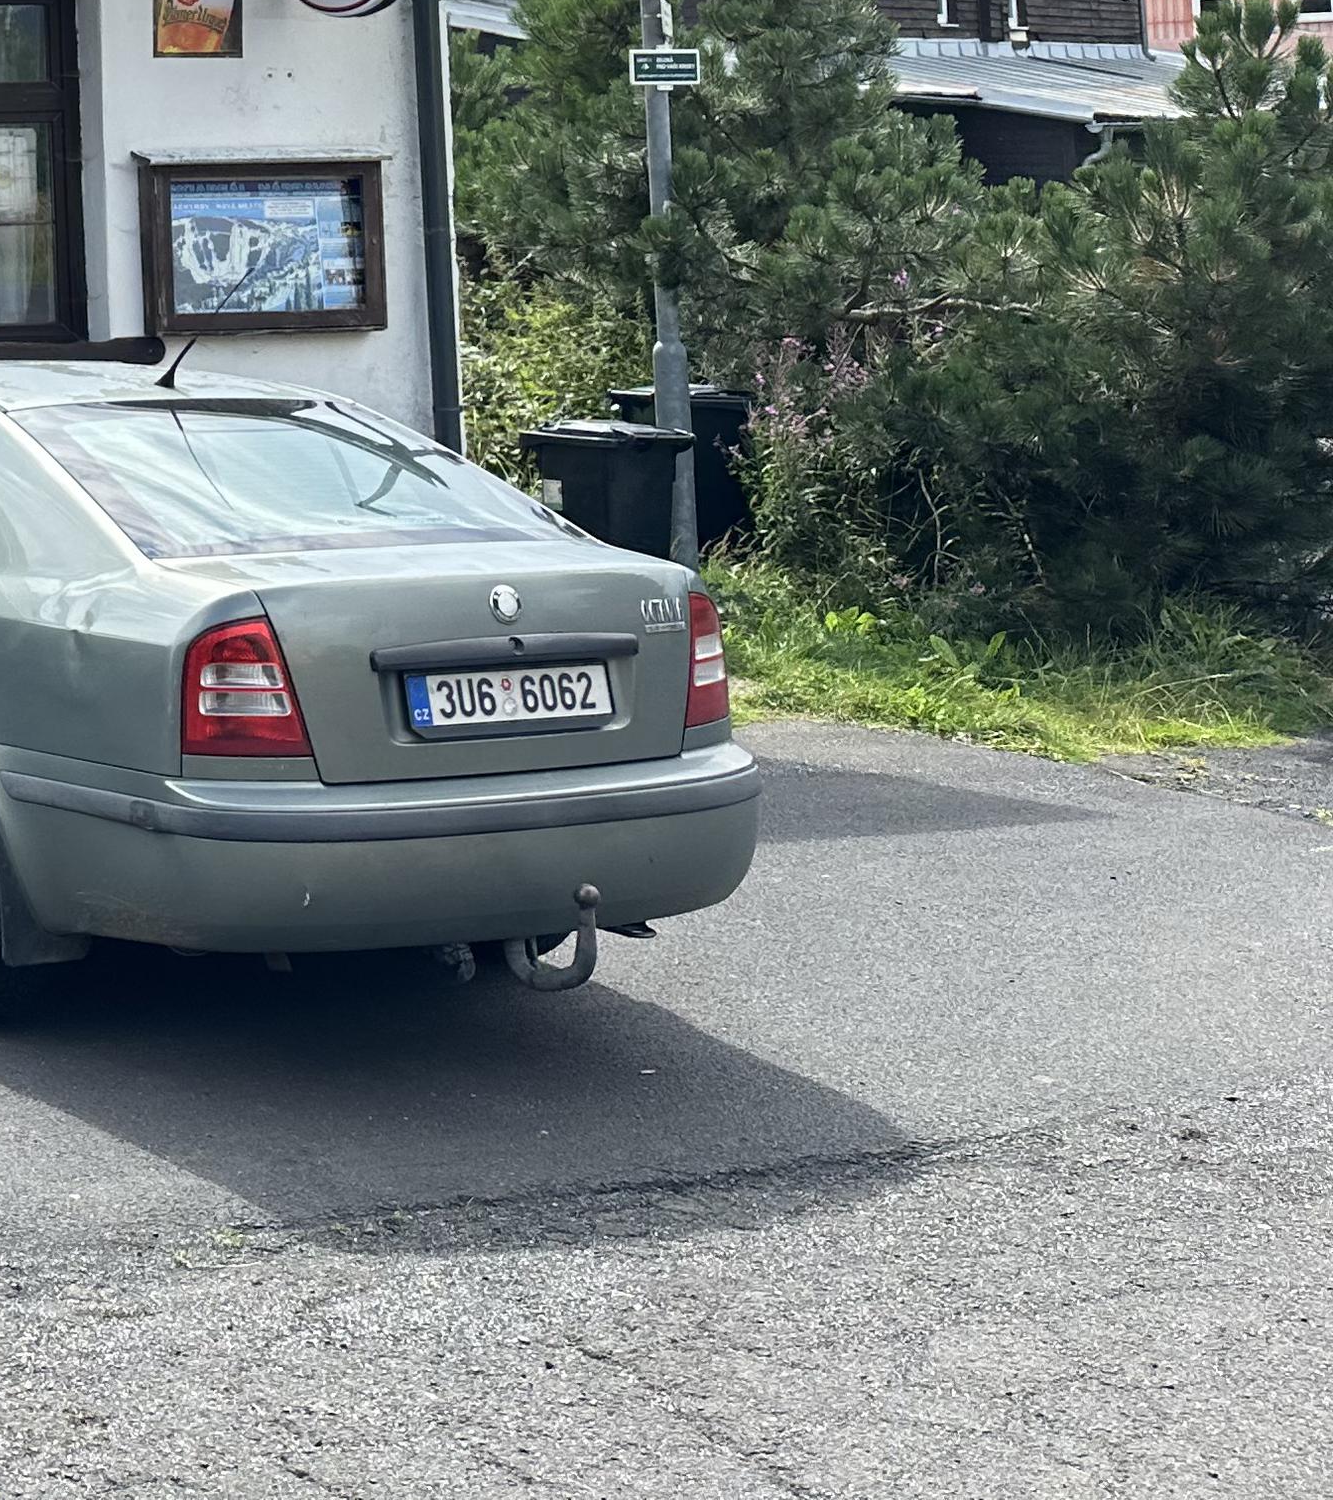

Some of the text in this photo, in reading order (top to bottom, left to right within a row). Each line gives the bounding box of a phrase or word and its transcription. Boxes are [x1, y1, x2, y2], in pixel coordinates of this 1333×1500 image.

[436, 672, 596, 719] 3U6 6062
[414, 708, 429, 721] CZ
